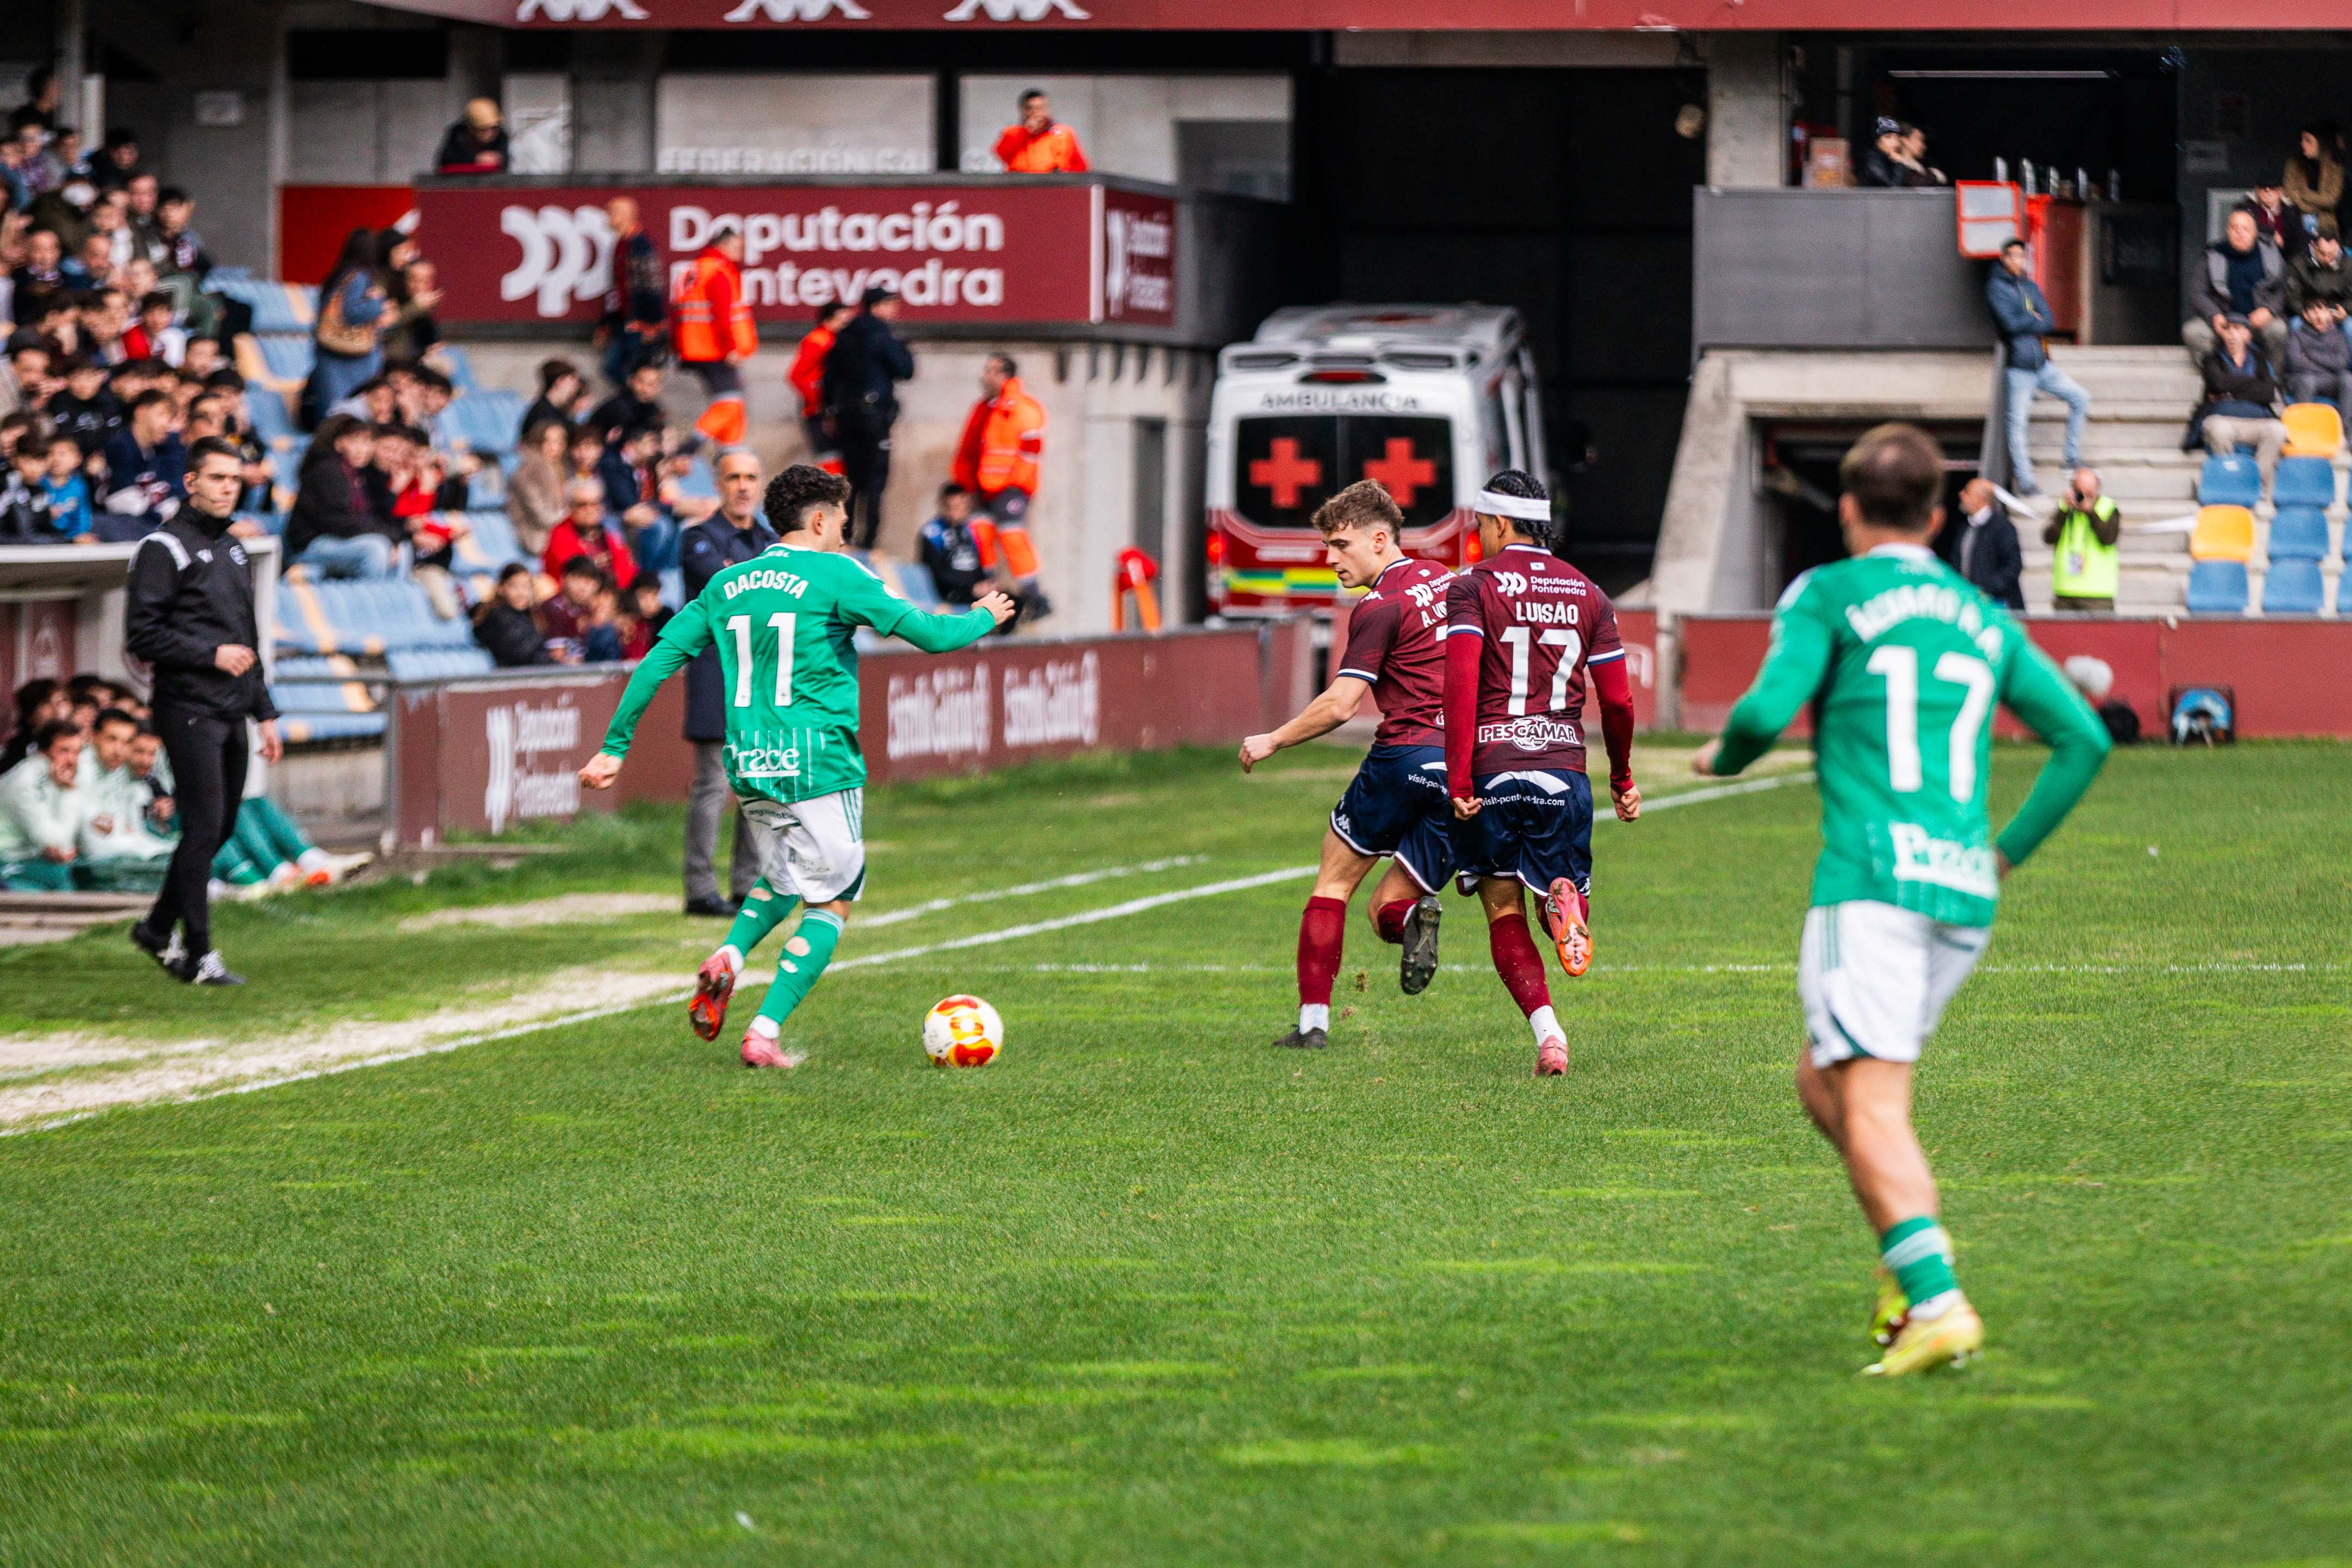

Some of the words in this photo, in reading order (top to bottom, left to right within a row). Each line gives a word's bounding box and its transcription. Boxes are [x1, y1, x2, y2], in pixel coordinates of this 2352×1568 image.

[670, 258, 1004, 306] ntevedra
[1259, 390, 1421, 409] AMBULANCA
[723, 570, 810, 600] DACOSTA
[1530, 576, 1585, 588] Deputación
[1532, 584, 1586, 596] Pontevedra
[1516, 601, 1579, 625] LUISÃO
[725, 612, 797, 707] 11
[1499, 626, 1582, 717] 17
[1478, 724, 1581, 745] PESCAMAR
[1865, 644, 1996, 804] 17
